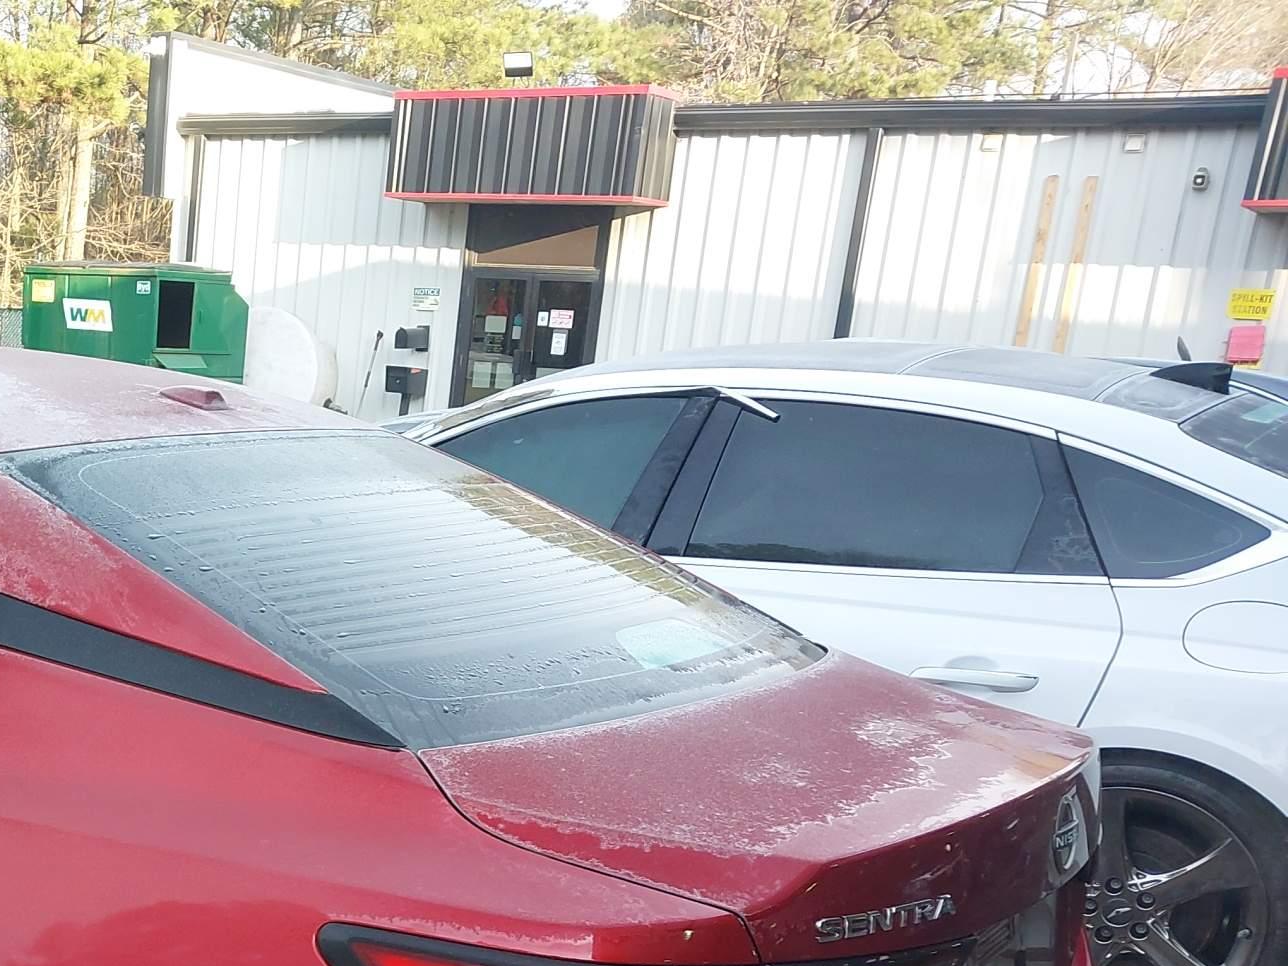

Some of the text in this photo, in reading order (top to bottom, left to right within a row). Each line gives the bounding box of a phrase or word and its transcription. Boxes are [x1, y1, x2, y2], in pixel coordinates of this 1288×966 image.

[414, 288, 440, 296] NOTICE
[1231, 293, 1274, 303] SPILL-KIT
[70, 307, 105, 323] WM
[1230, 305, 1268, 315] STATION
[815, 894, 956, 943] SENTRA
